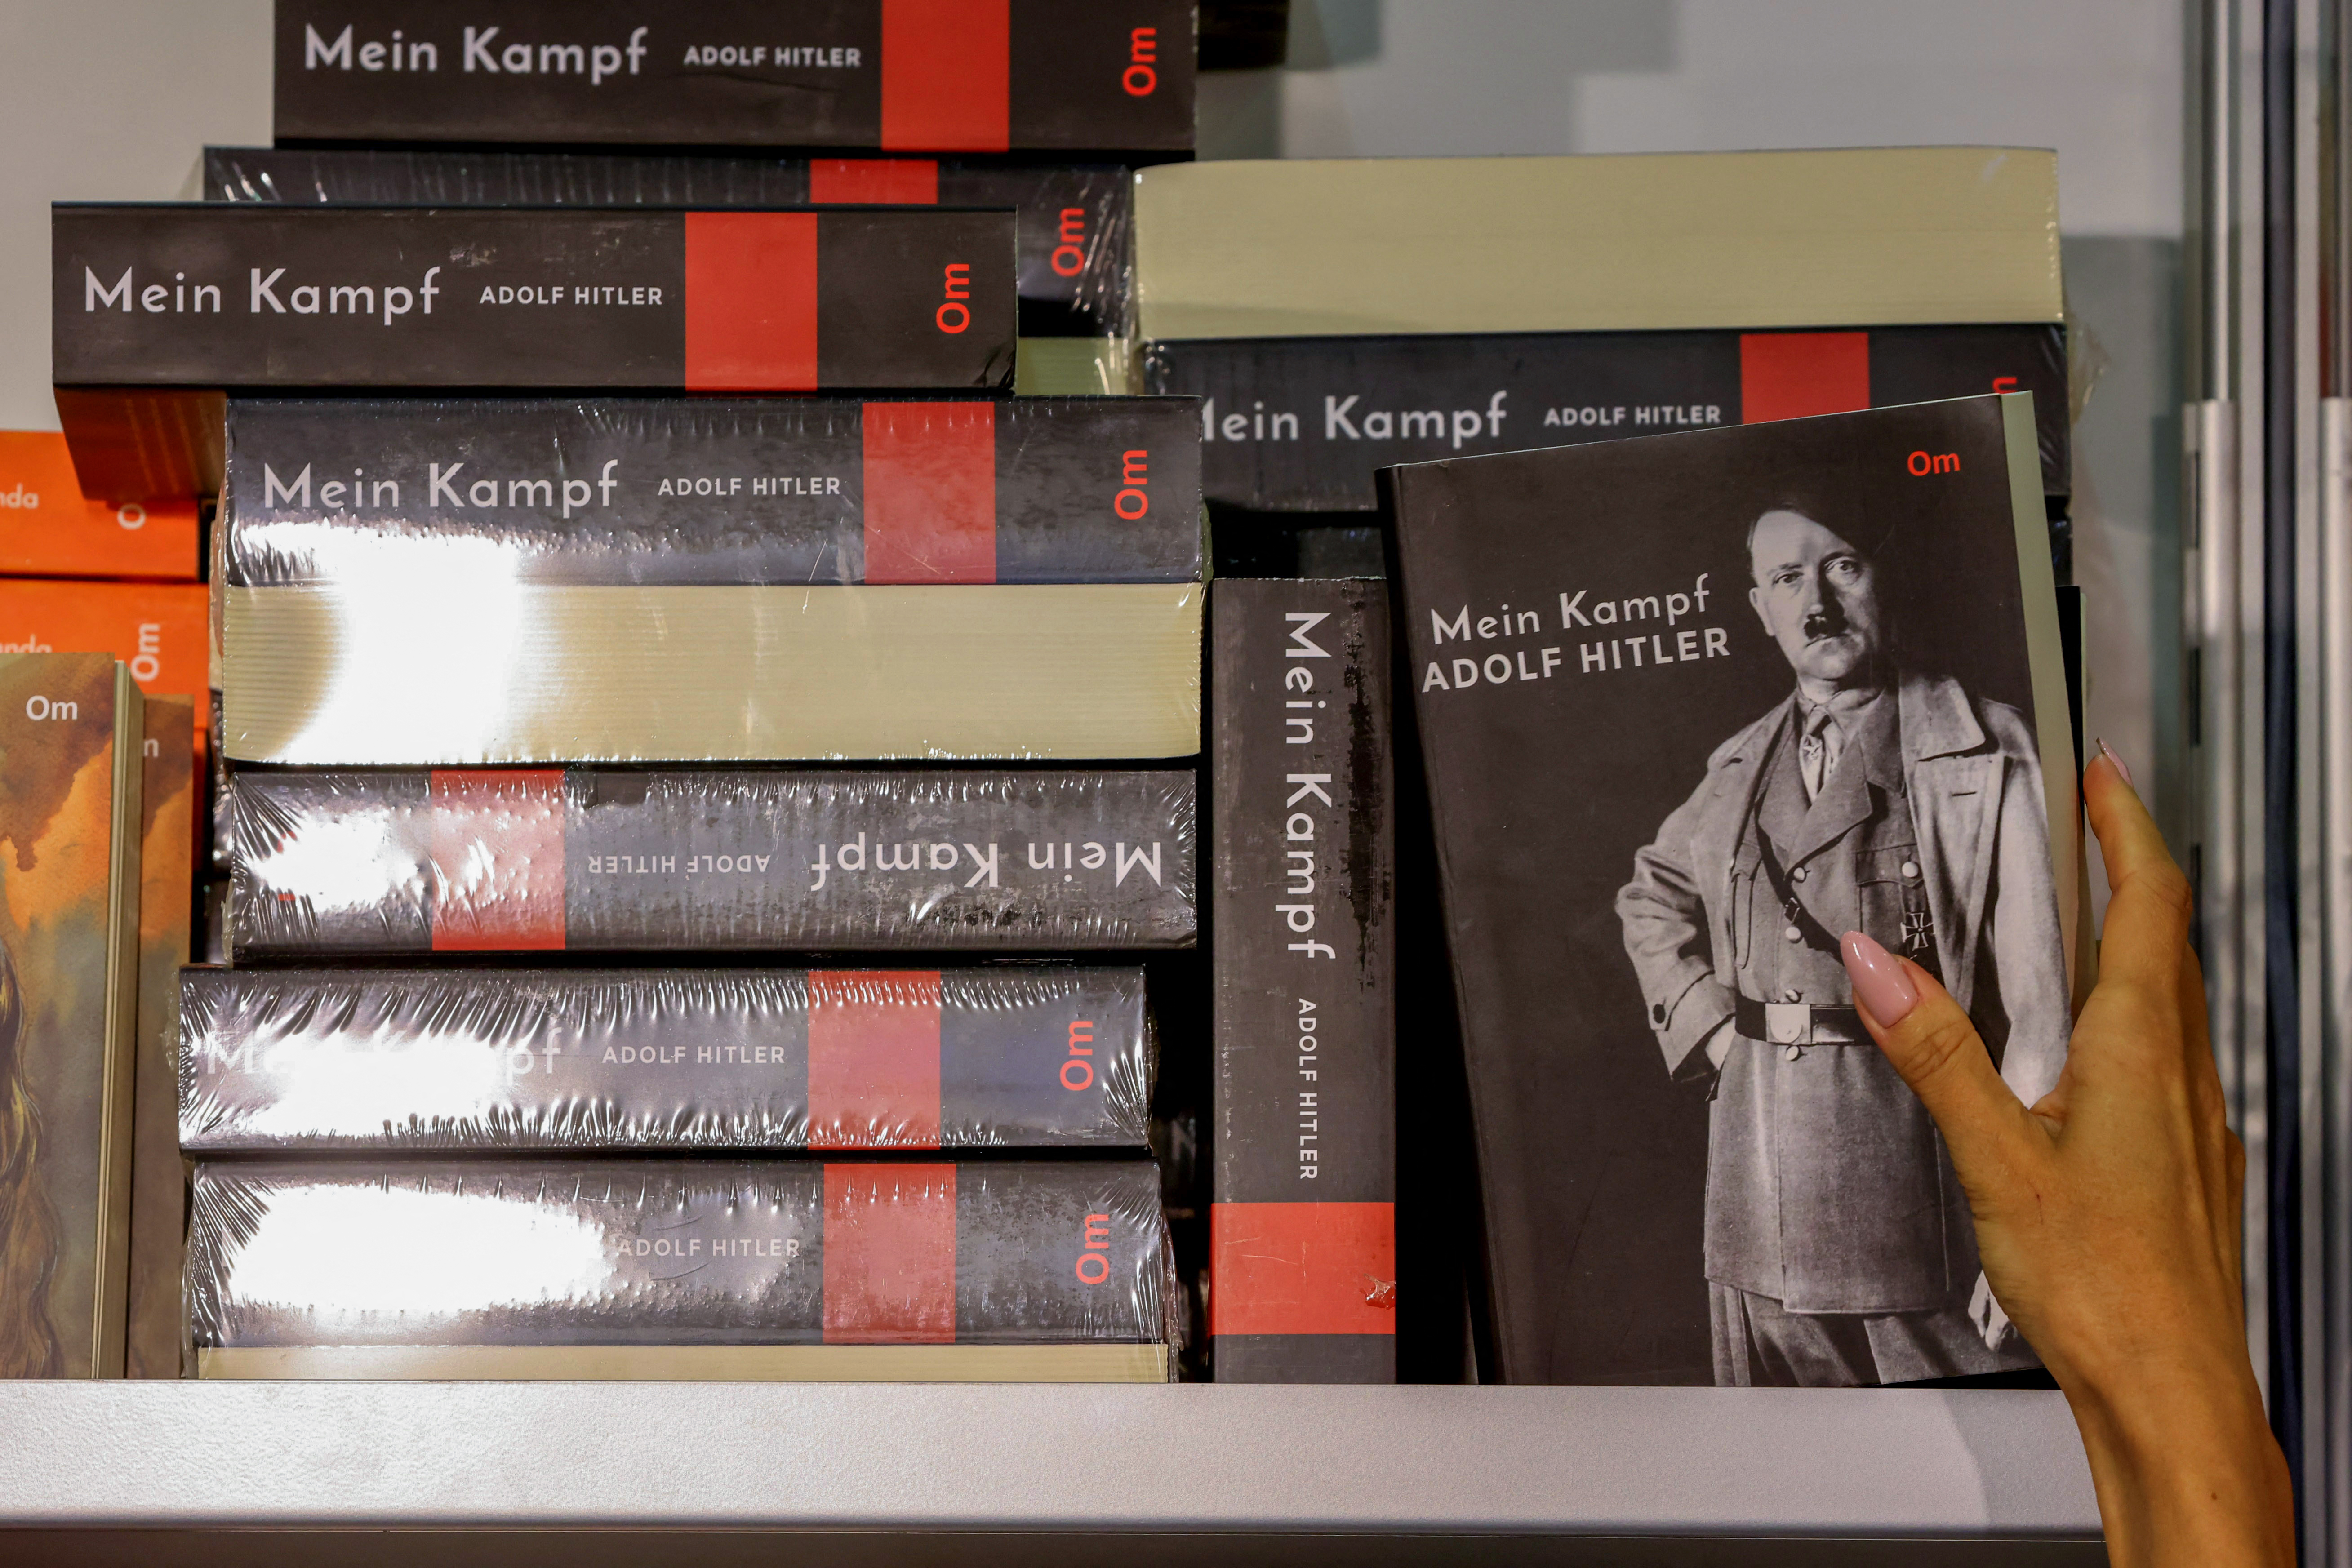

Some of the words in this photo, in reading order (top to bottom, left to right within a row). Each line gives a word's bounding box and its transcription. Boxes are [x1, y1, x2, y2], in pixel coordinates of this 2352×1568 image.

[305, 24, 437, 71] Mein
[464, 27, 647, 83] Kampf
[684, 46, 765, 65] ADOLF
[774, 48, 860, 67] HITLER
[1122, 27, 1158, 97] Om
[1051, 208, 1085, 277] Om
[85, 265, 221, 313] Mein
[250, 266, 440, 326] Kampf
[479, 286, 565, 305] ADOLF
[574, 286, 663, 305] HITLER
[935, 263, 971, 334] Om
[1325, 390, 1507, 449] Kampf
[1544, 406, 1625, 426] ADOLF
[1635, 405, 1721, 424] HITLER
[265, 462, 399, 508] Mein
[429, 459, 618, 519] Kampf
[658, 477, 742, 496] ADOLF
[753, 477, 840, 495] HITLER
[1113, 449, 1149, 520] Om
[1907, 450, 1961, 476] Om
[1431, 604, 1540, 645] Mein
[1560, 573, 1710, 629] Kampf
[130, 623, 160, 682] Om
[1285, 612, 1332, 744] Mein
[1422, 647, 1561, 693] ADOLF
[1580, 627, 1730, 673] HITLER
[26, 695, 78, 720] Om
[587, 855, 676, 874] HITLER
[686, 855, 771, 873] ADOLF
[809, 831, 999, 891] Kampf
[1027, 841, 1162, 888] Mein
[1275, 773, 1336, 959] Kampf
[601, 1045, 686, 1064] ADOLF
[697, 1045, 786, 1064] HITLER
[1059, 1020, 1094, 1091] Om
[1298, 997, 1318, 1082] ADOLF
[1299, 1092, 1318, 1180] HITLER
[618, 1238, 702, 1257] ADOLF
[712, 1238, 800, 1257] HITLER
[1075, 1213, 1110, 1285] Om
